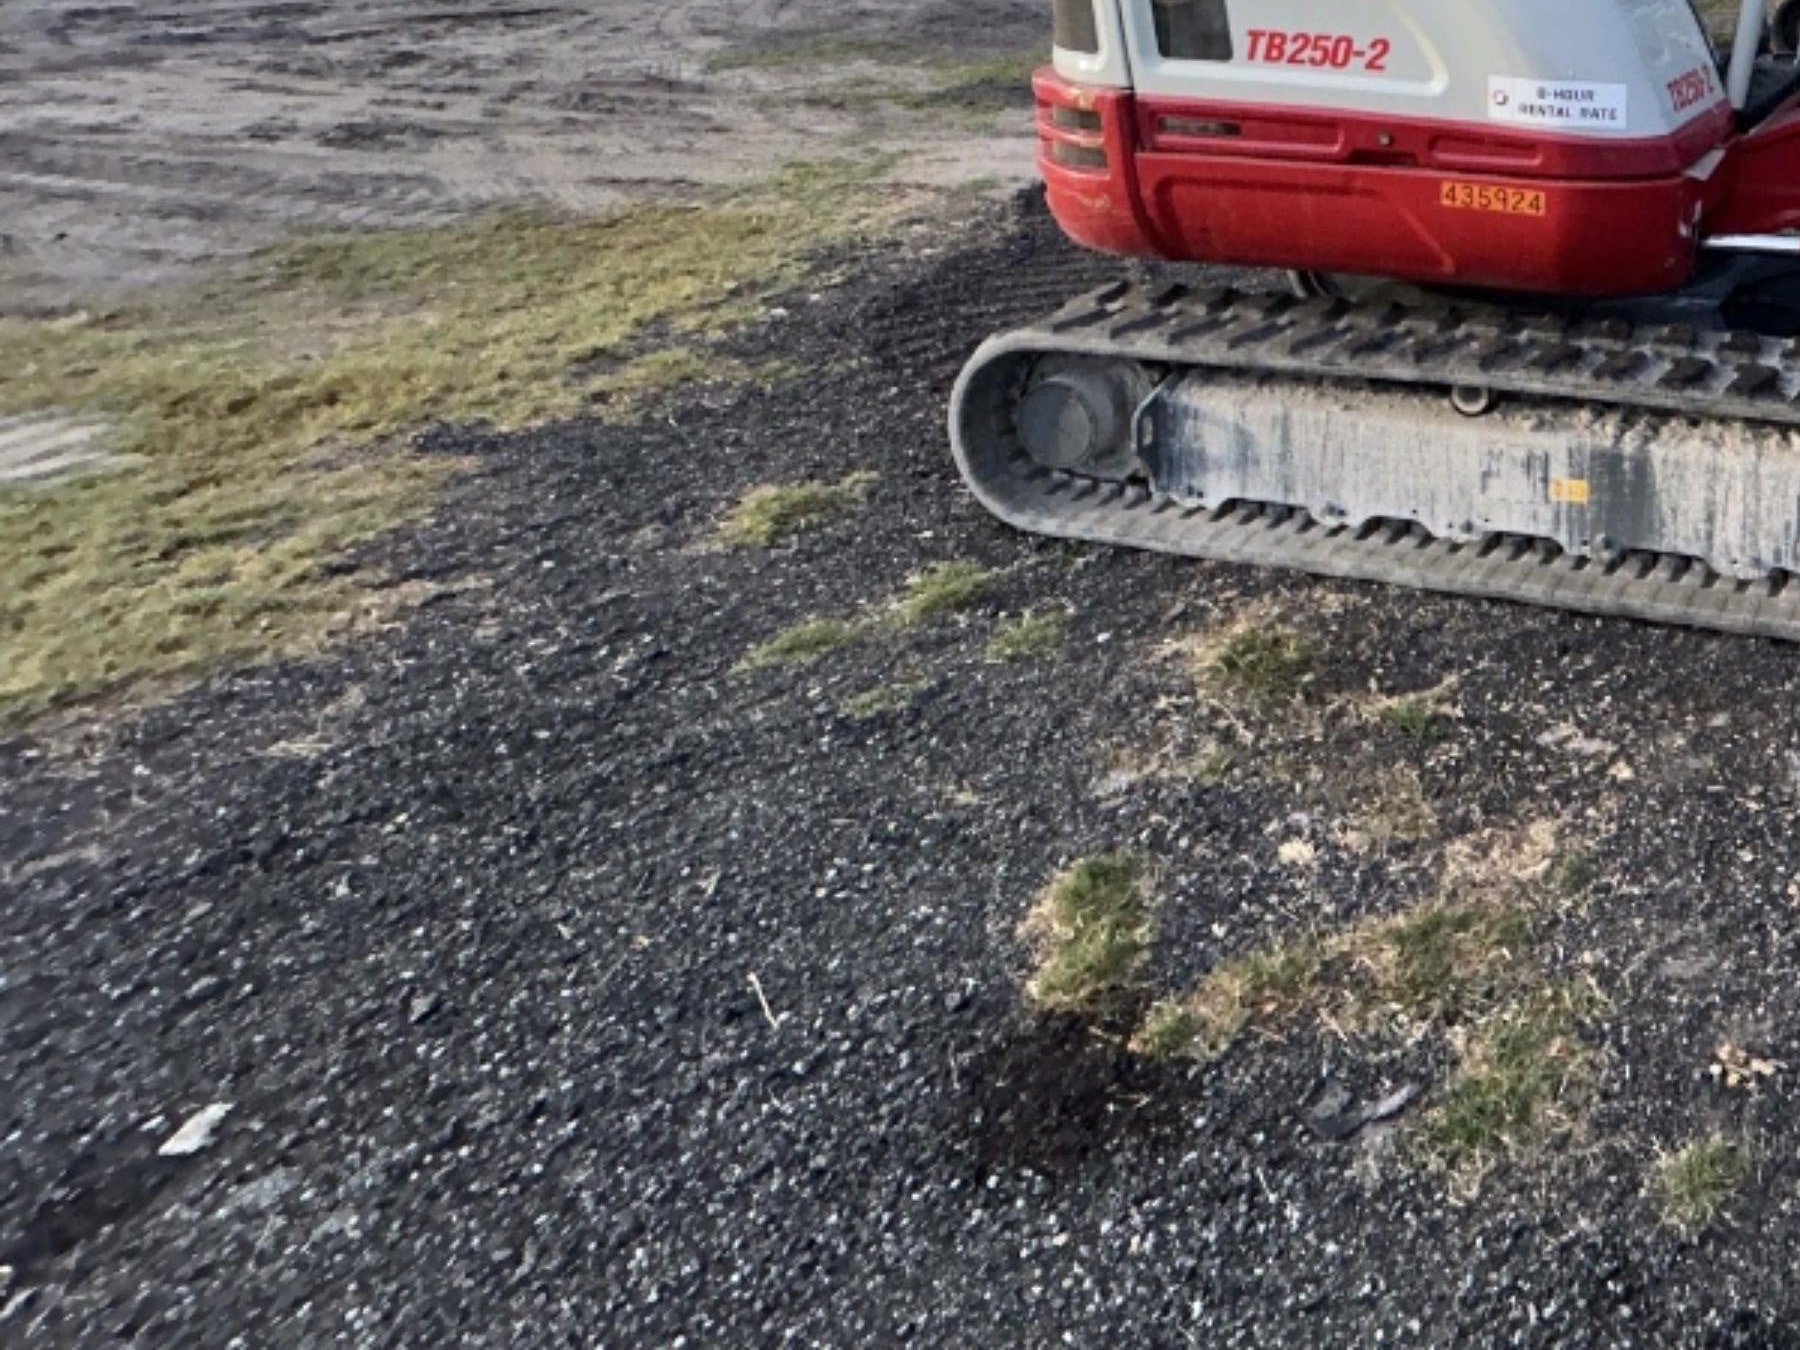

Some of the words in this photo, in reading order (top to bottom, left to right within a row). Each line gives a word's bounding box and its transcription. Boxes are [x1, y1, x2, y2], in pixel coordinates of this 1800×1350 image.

[1246, 29, 1391, 71] TB250-2
[1517, 103, 1571, 119] RENTAL
[1579, 107, 1618, 121] RATE
[1444, 185, 1541, 212] 435924
